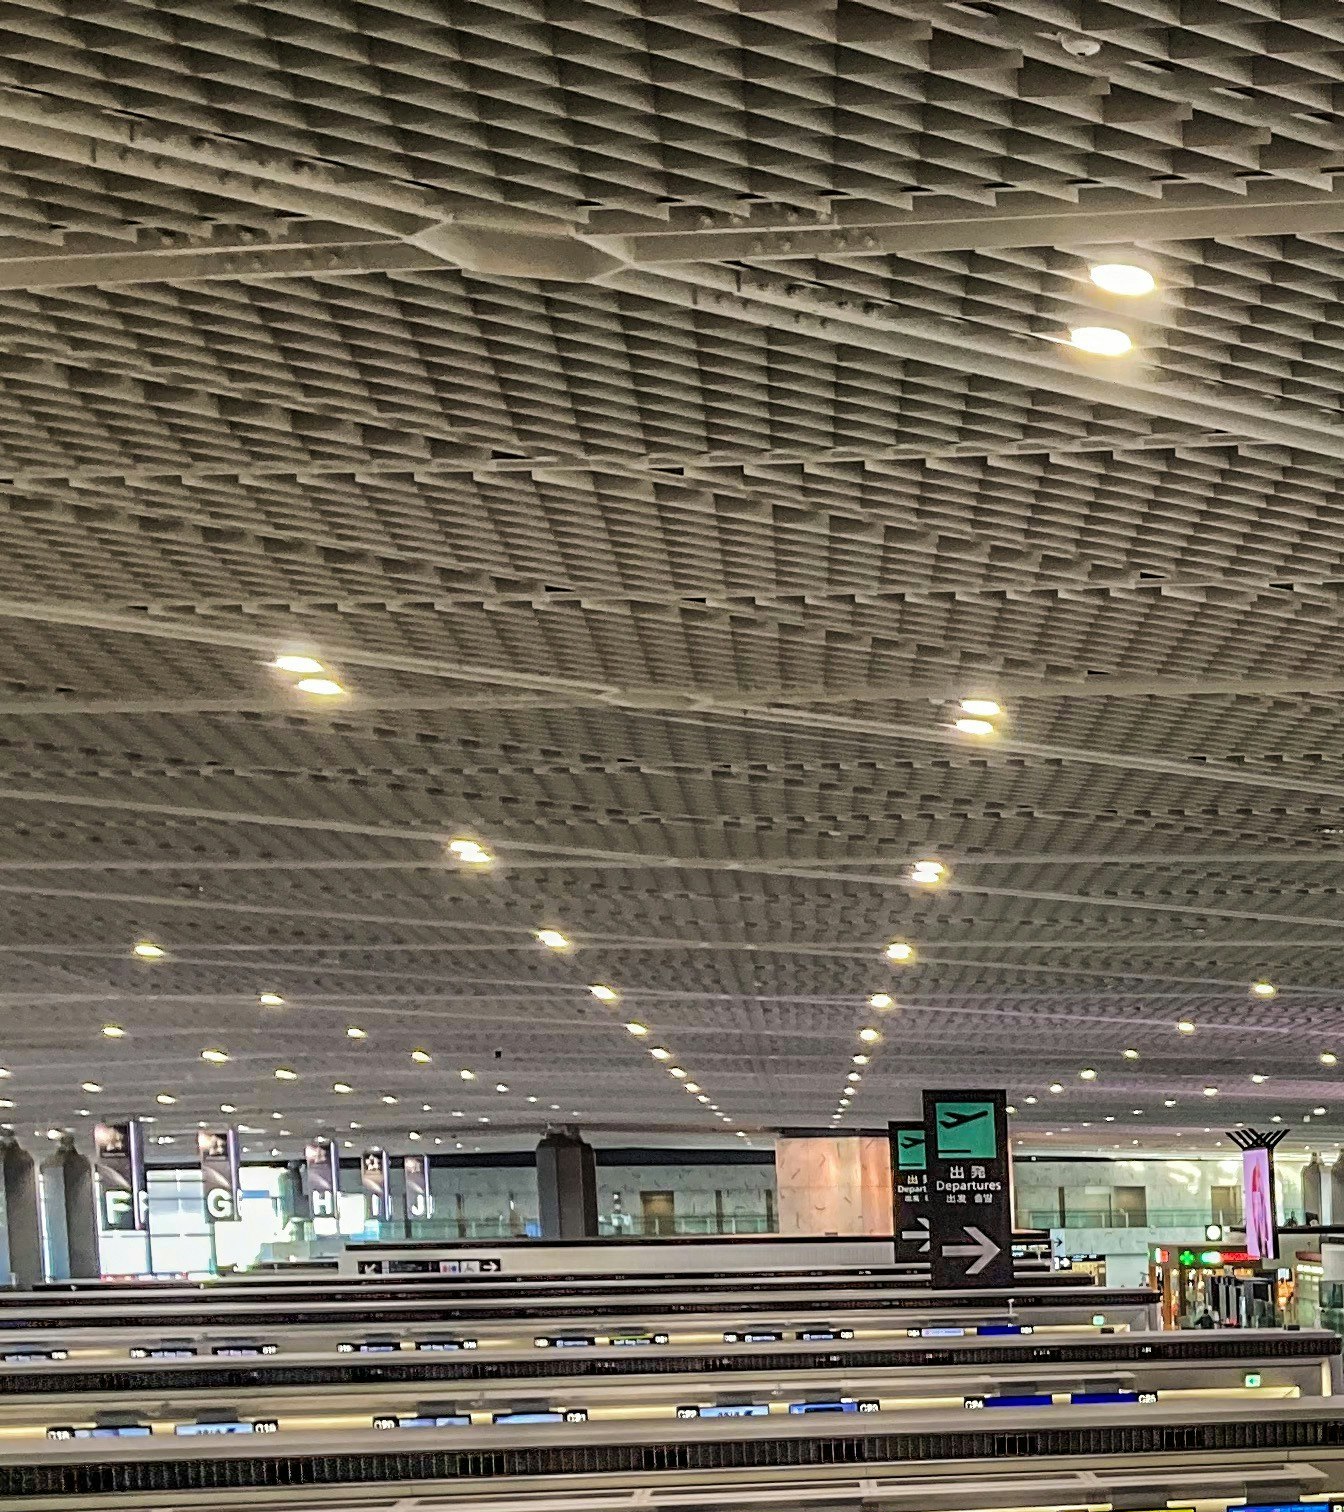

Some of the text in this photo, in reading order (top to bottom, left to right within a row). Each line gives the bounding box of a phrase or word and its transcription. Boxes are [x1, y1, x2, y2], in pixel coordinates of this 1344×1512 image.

[898, 1185, 927, 1194] Depart
[937, 1180, 1001, 1193] Departures
[105, 1190, 131, 1225] F
[207, 1188, 233, 1217] G
[312, 1190, 332, 1215] H
